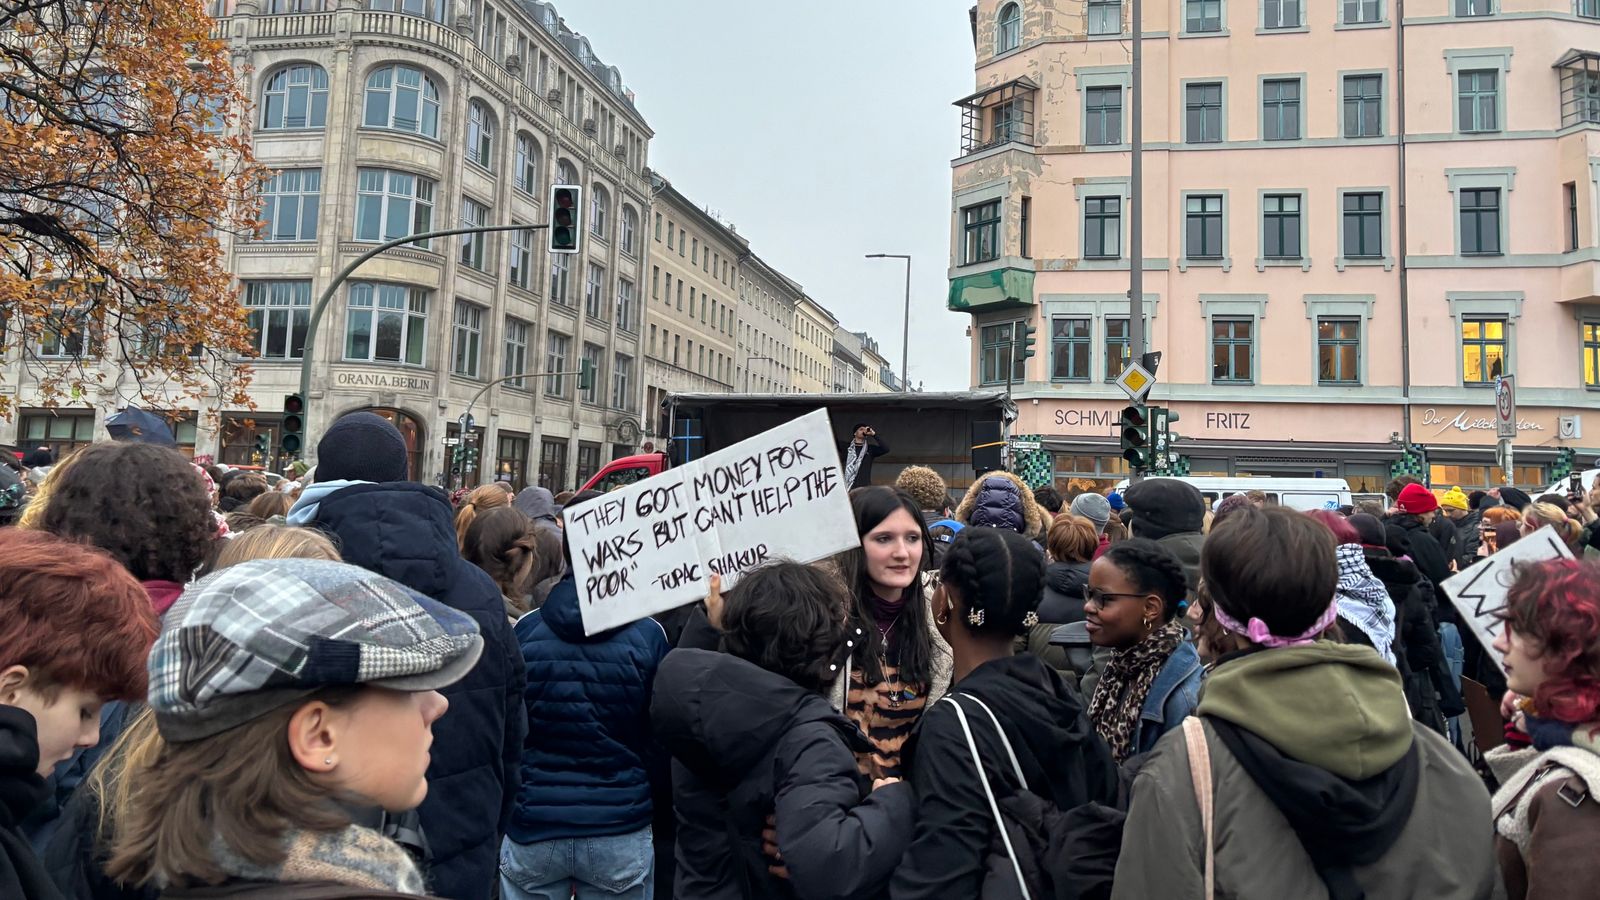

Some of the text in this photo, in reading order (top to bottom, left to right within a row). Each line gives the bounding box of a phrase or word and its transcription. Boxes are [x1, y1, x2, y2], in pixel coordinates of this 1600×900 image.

[337, 372, 430, 390] ORANIA.BERLIN
[1206, 411, 1250, 430] FRITZ
[635, 481, 684, 518] GOT
[694, 453, 762, 501] MONEY
[766, 438, 815, 477] FOR
[582, 529, 643, 573] WARS
[652, 511, 688, 550] BUT
[751, 476, 801, 517] HELP
[802, 466, 838, 502] THE
[707, 543, 769, 577] SHAKUR
